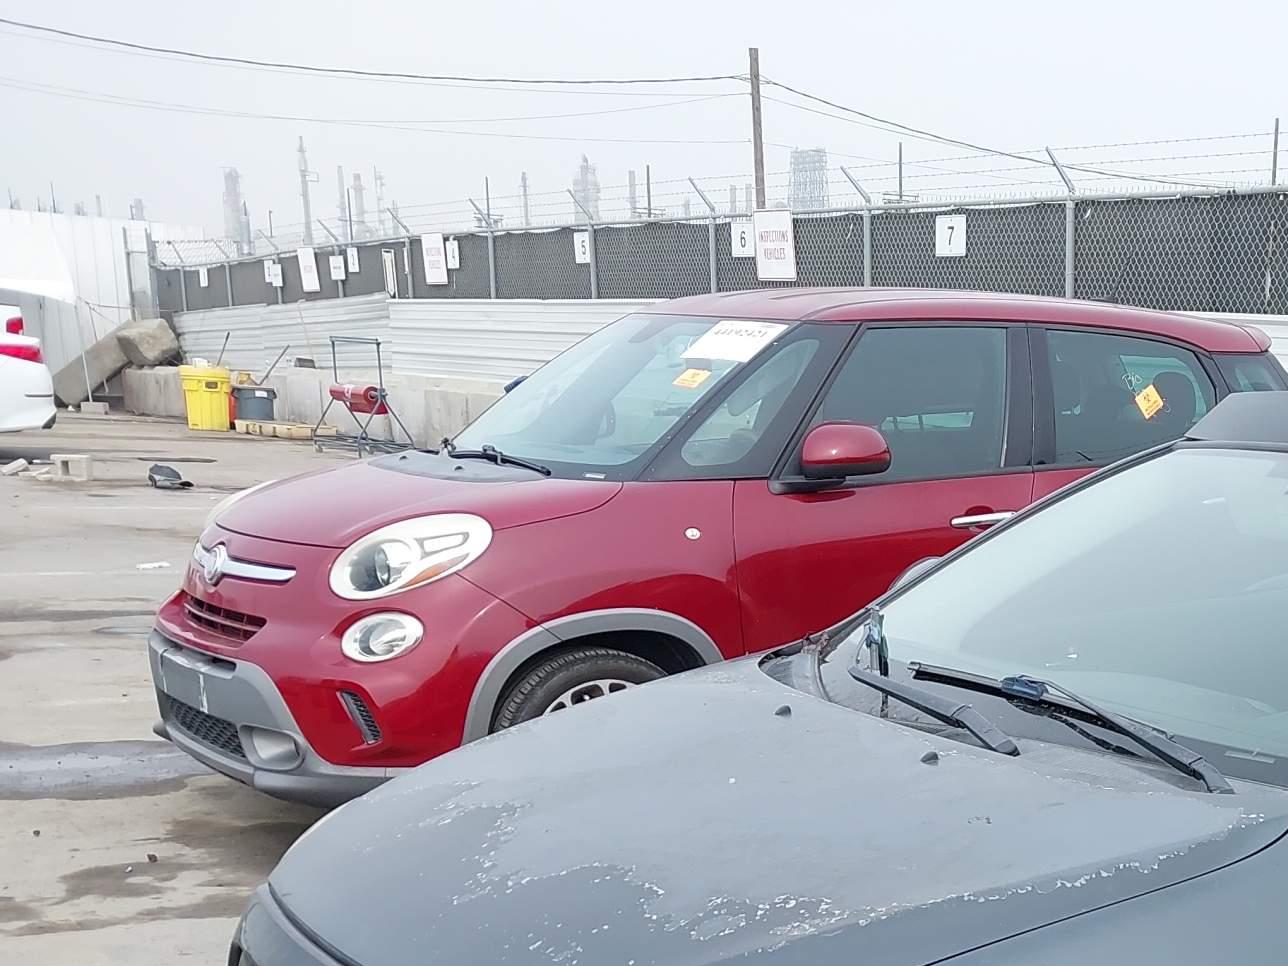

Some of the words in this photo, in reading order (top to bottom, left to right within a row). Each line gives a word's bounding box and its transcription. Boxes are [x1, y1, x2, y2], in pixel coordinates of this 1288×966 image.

[740, 231, 747, 248] 6
[947, 226, 954, 245] 7
[581, 240, 587, 256] 5
